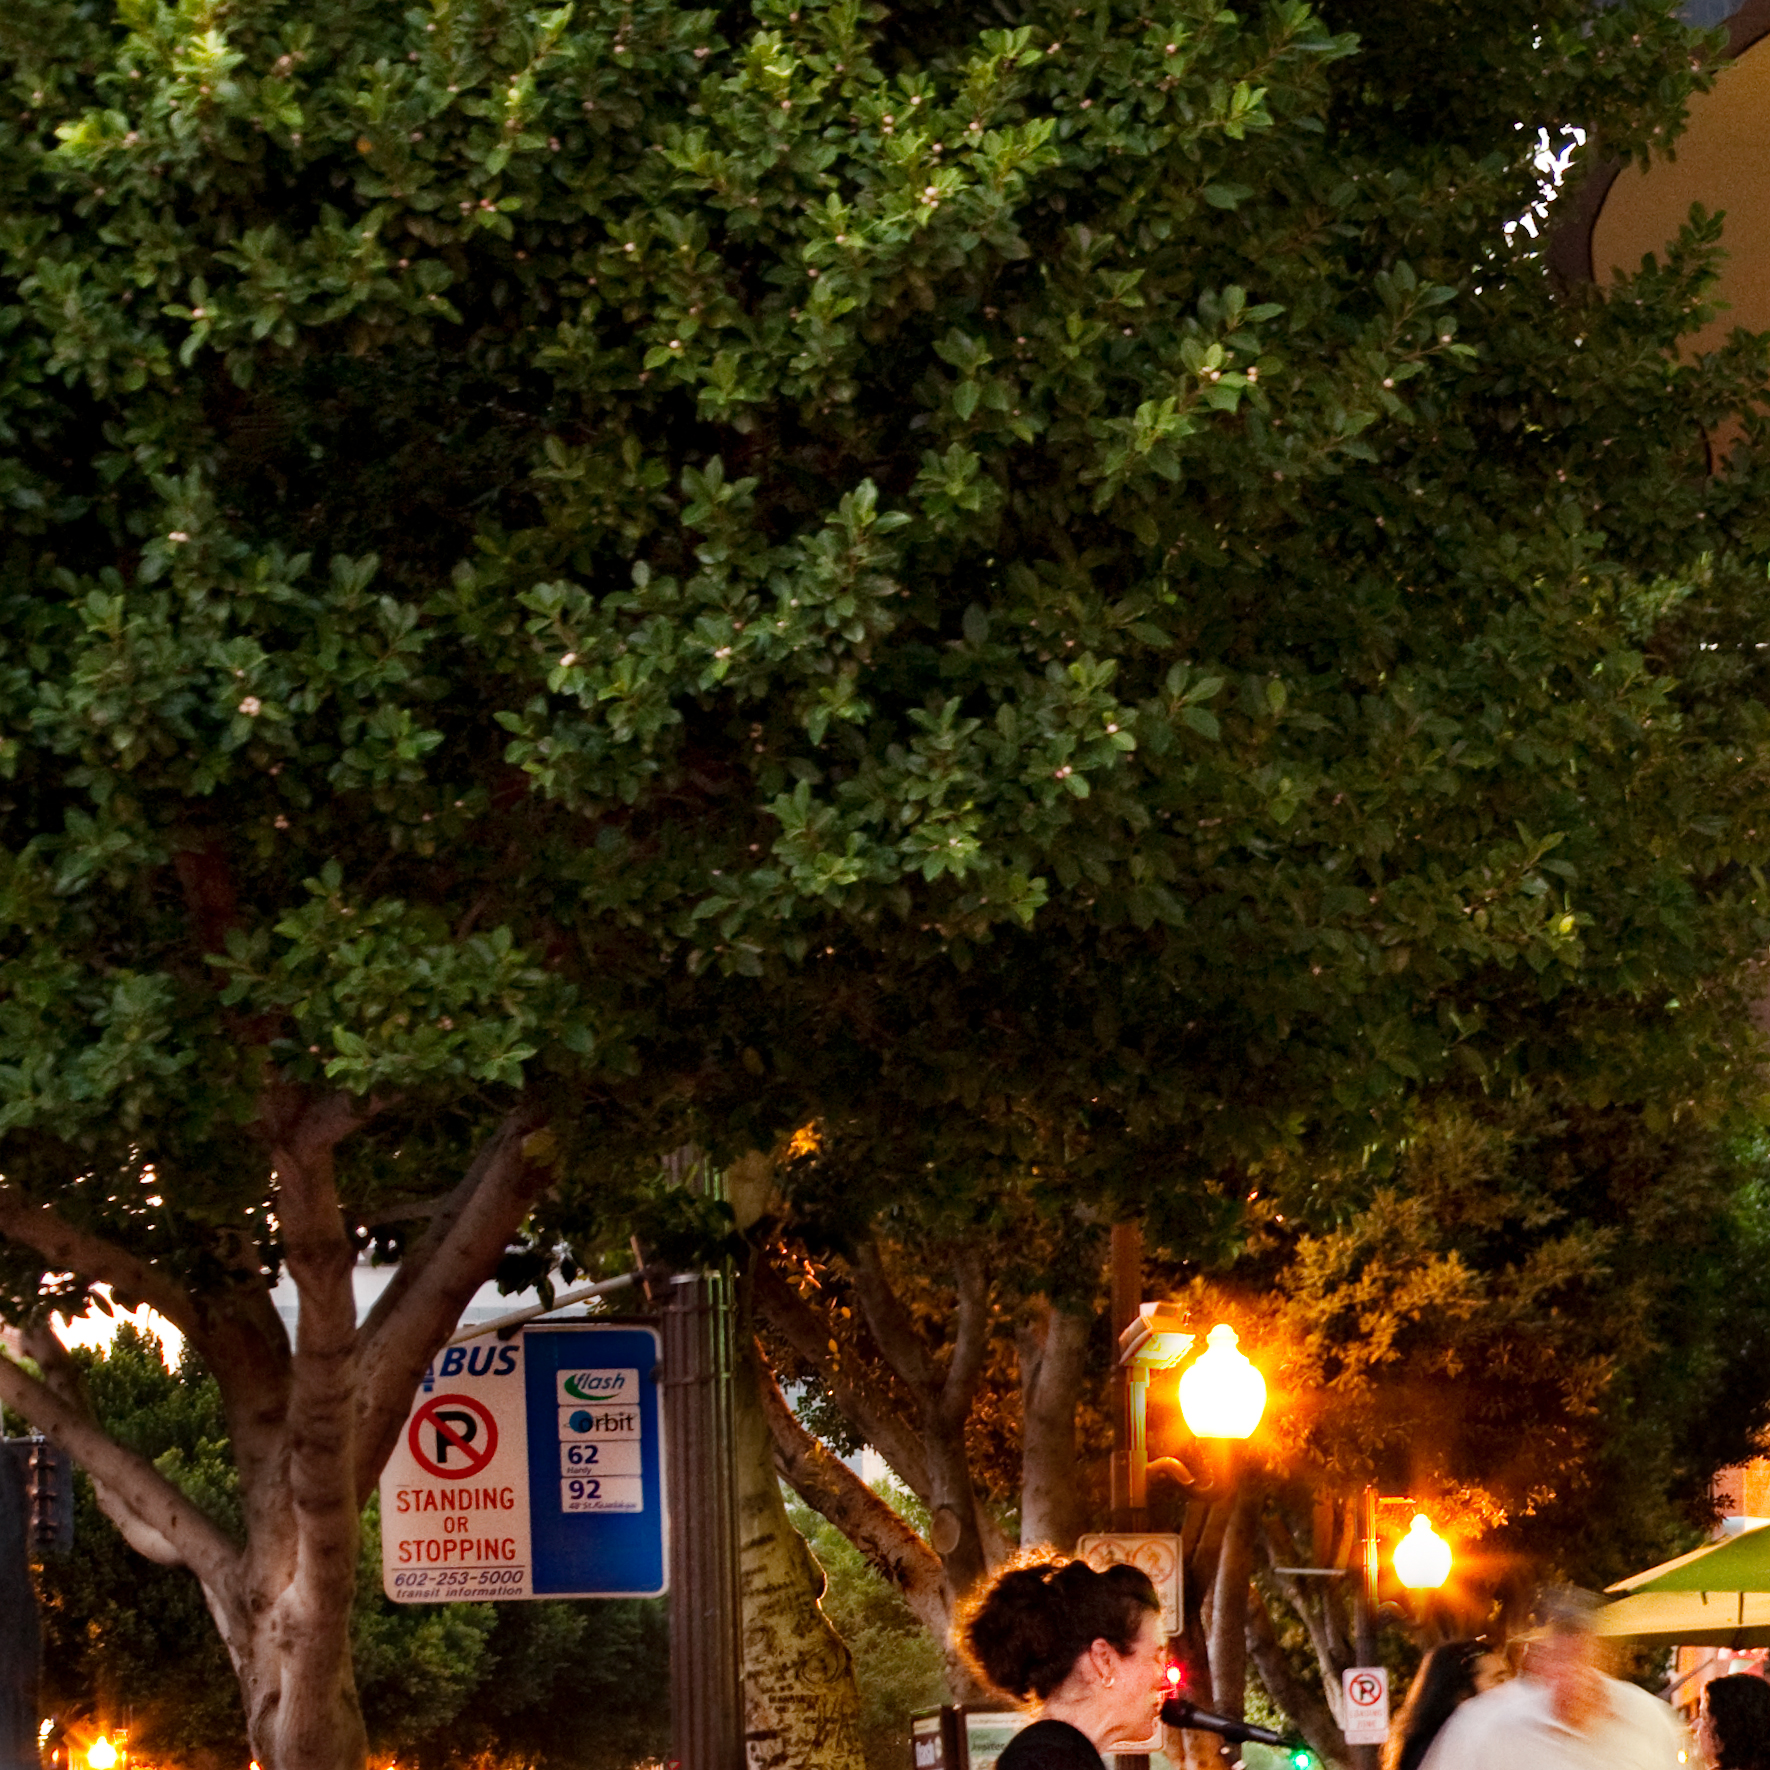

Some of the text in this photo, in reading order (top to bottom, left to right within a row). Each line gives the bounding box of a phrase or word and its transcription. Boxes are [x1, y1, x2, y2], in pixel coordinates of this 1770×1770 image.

[440, 1346, 520, 1376] BUS
[575, 1373, 625, 1390] flash
[578, 1412, 635, 1433] orbit
[568, 1445, 599, 1465] 62
[396, 1486, 515, 1513] STANDING
[569, 1480, 602, 1500] 92
[443, 1516, 469, 1534] OR
[398, 1538, 516, 1563] STOPPING
[394, 1570, 524, 1587] 602-253-5000
[396, 1586, 523, 1599] transit information
